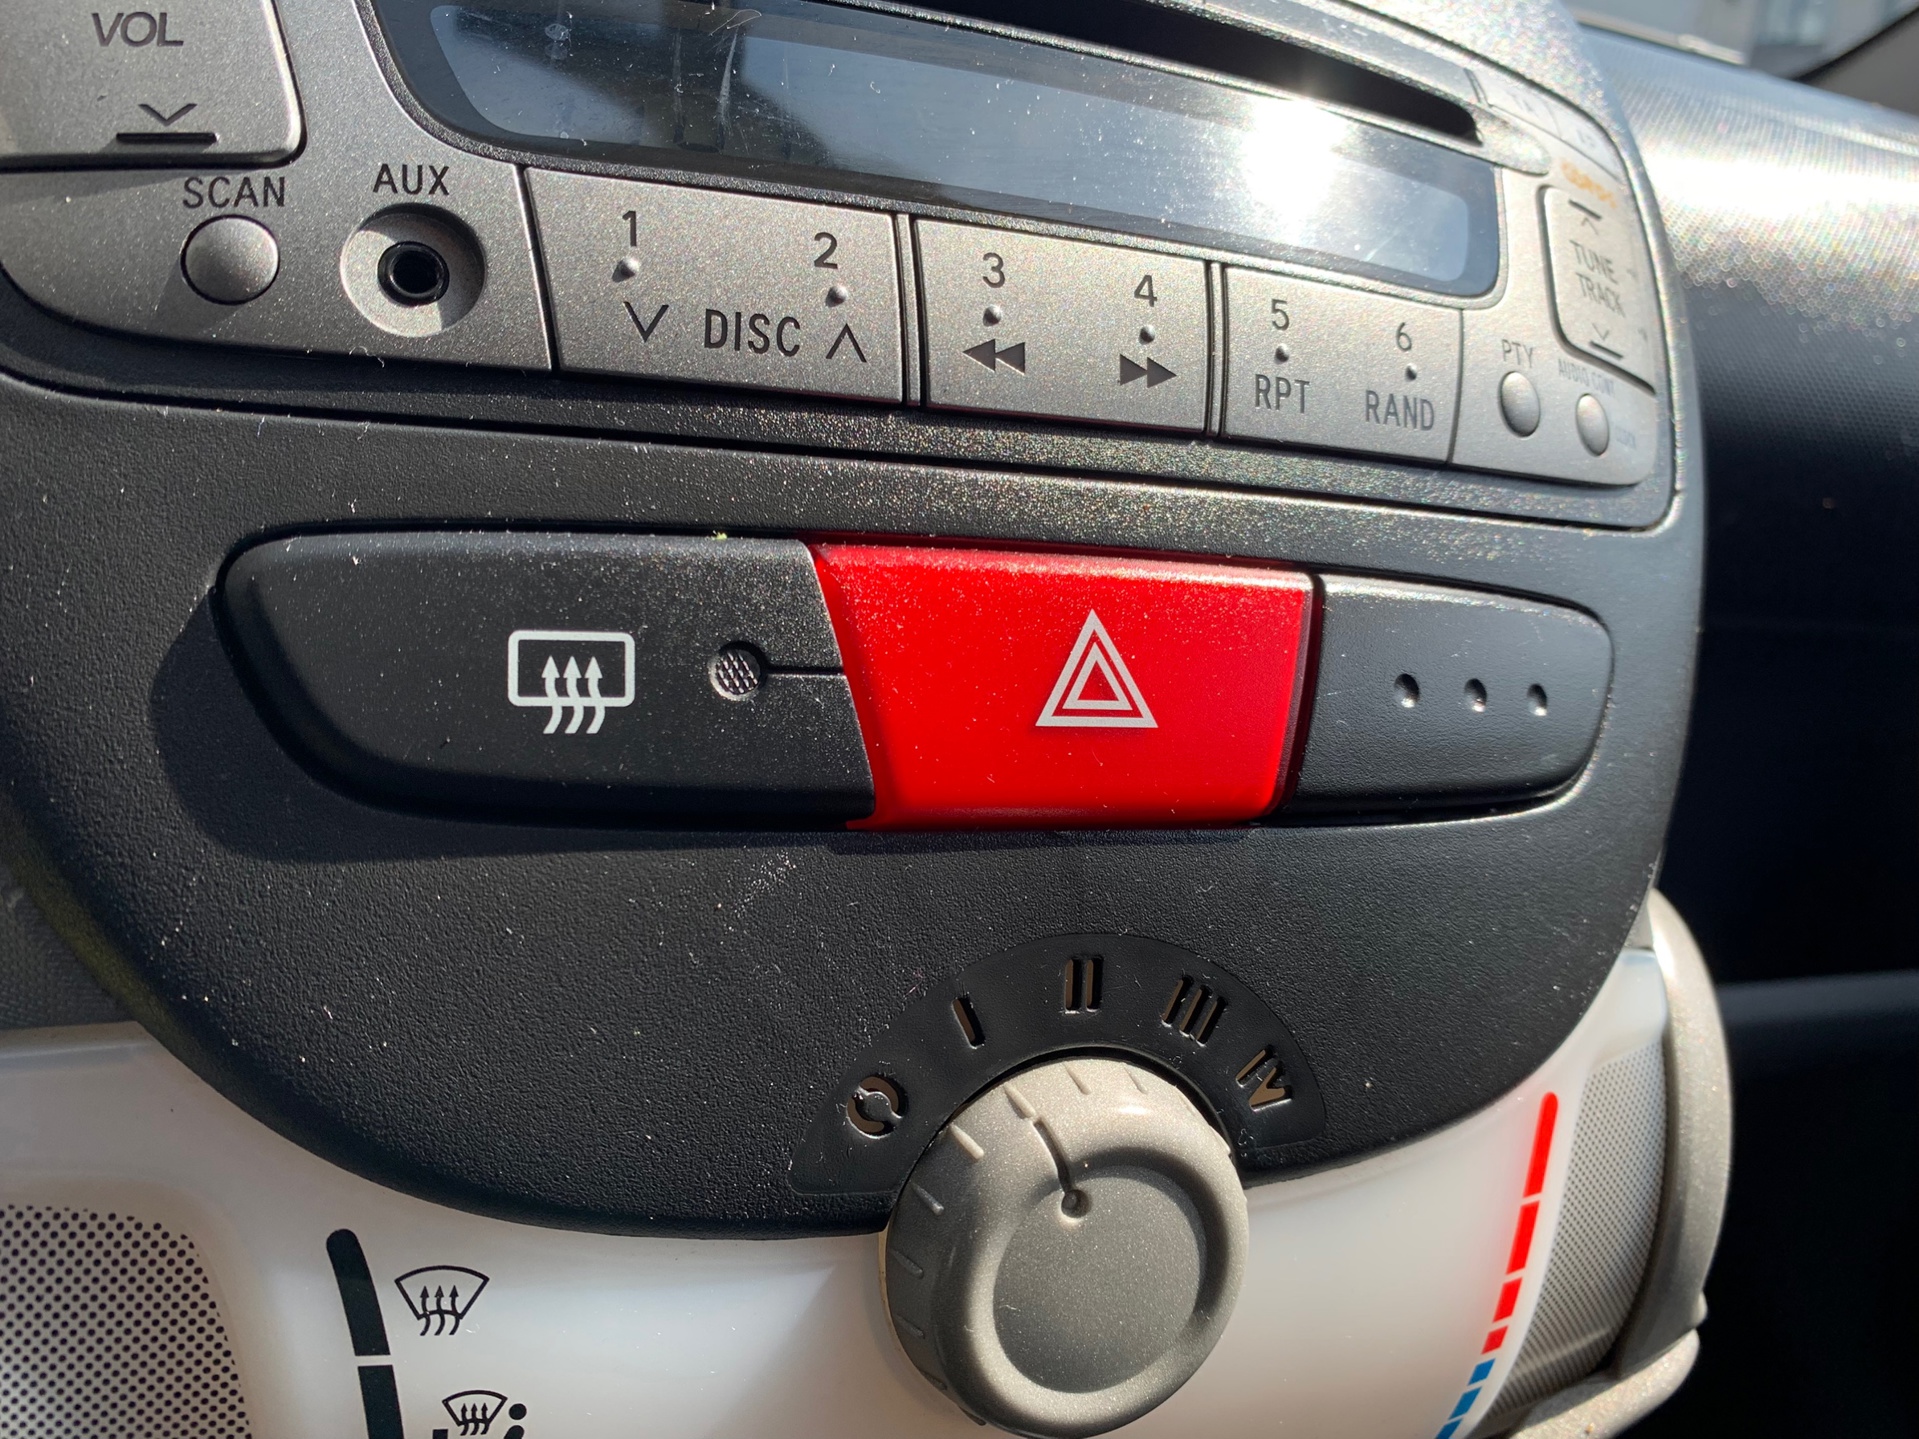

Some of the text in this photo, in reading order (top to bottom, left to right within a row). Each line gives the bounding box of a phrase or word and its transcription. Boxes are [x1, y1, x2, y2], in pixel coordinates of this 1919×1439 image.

[92, 12, 184, 47] VOL
[183, 177, 286, 208] SCAN
[373, 164, 450, 195] AUX
[621, 209, 638, 247] 1
[813, 231, 839, 270] 2
[1569, 239, 1618, 285] TUNE
[982, 252, 1006, 289] 3
[1133, 274, 1158, 308] 4
[703, 308, 800, 357] DISC
[1270, 298, 1291, 331] 5
[1395, 322, 1412, 352] 6
[1501, 338, 1534, 369] PTY
[1254, 373, 1311, 414] RPT
[1364, 389, 1435, 432] RAND
